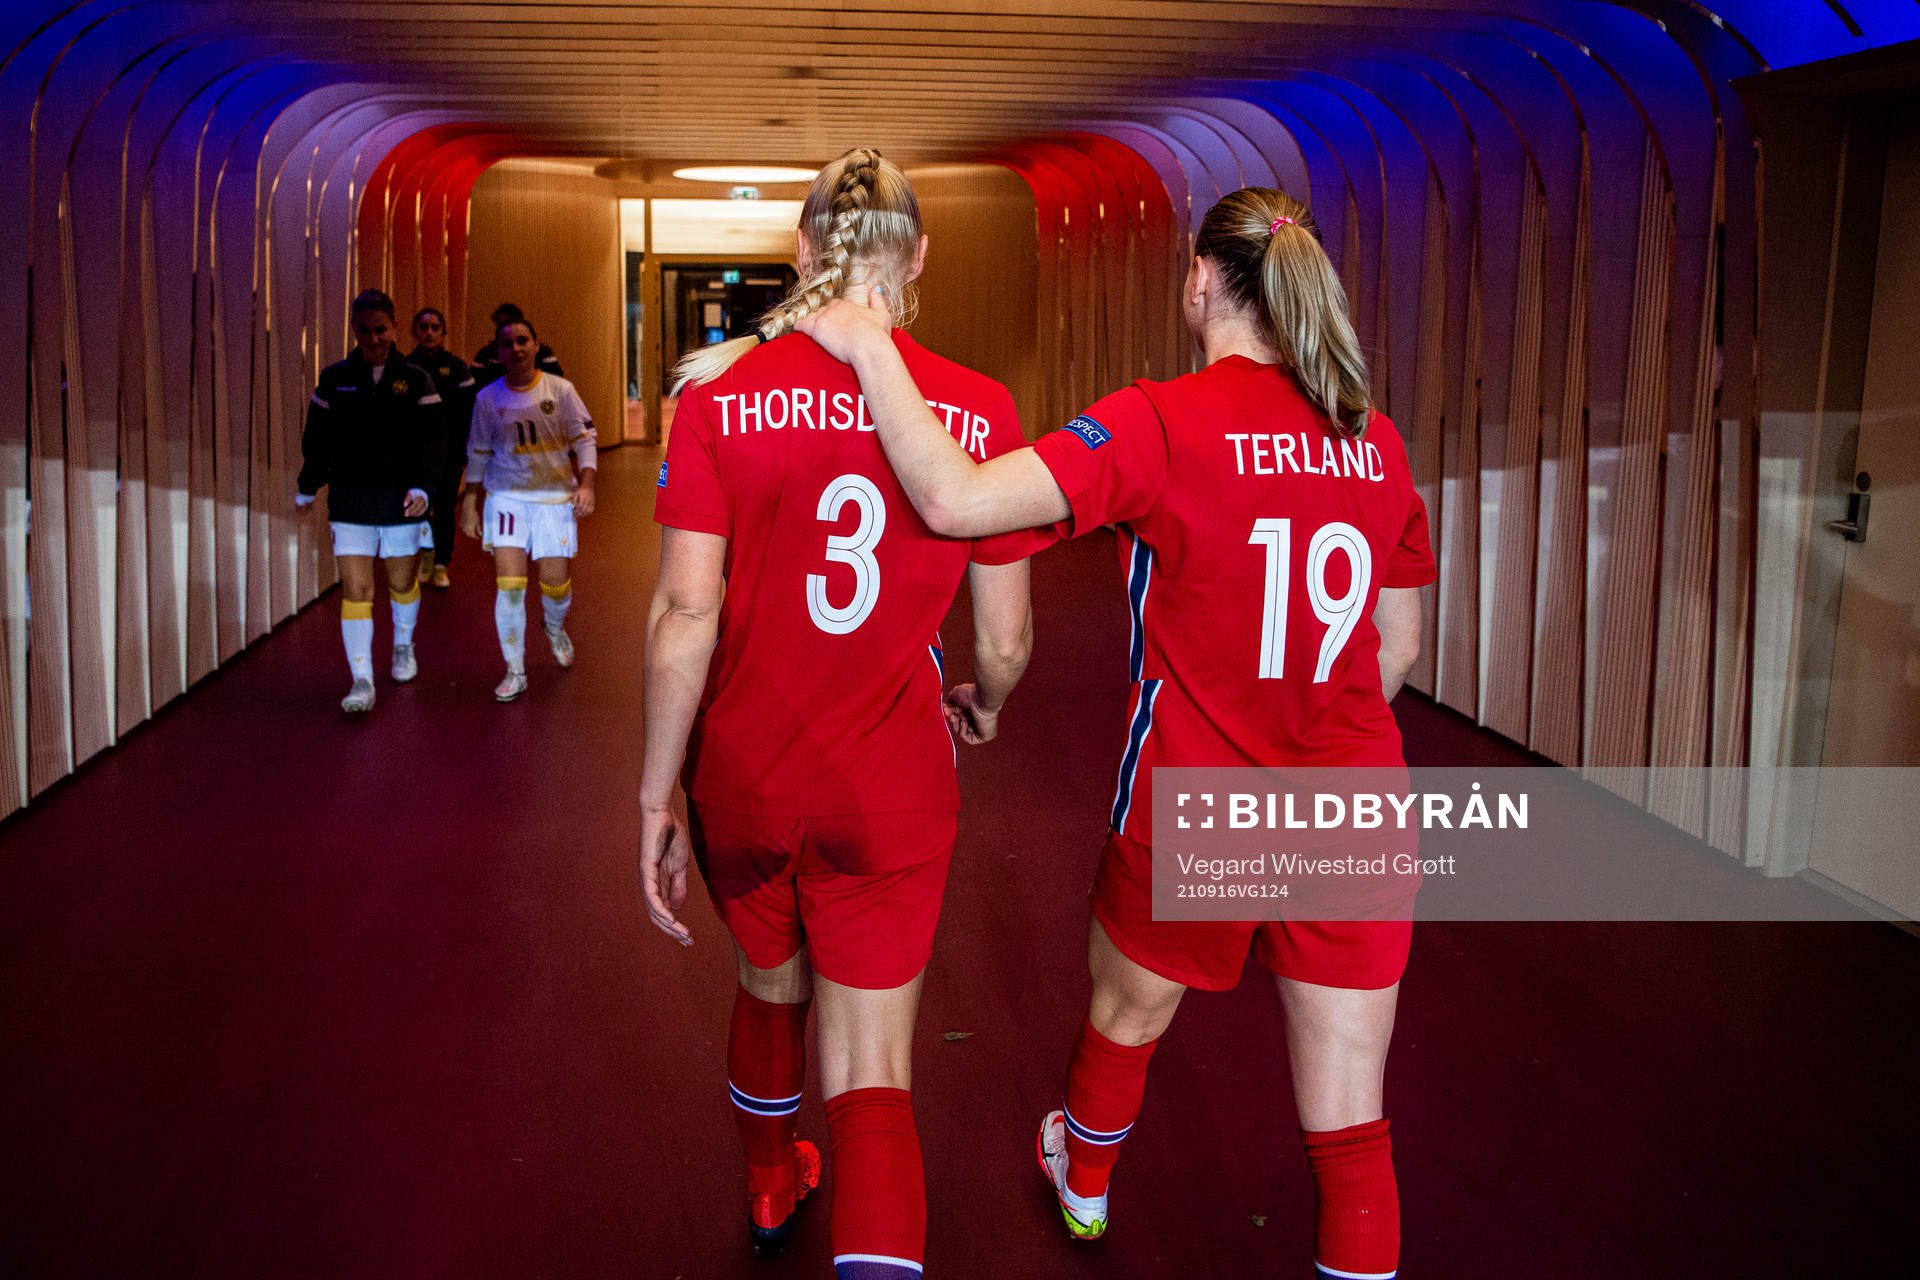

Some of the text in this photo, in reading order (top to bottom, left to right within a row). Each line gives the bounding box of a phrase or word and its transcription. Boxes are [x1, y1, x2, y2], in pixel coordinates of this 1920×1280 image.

[514, 420, 537, 446] 11
[713, 388, 990, 460] THORISDTIR
[1066, 419, 1106, 444] ESPECT
[1225, 432, 1385, 482] TERLAND
[498, 511, 515, 536] 11
[806, 474, 886, 634] 3
[1247, 518, 1372, 683] 19
